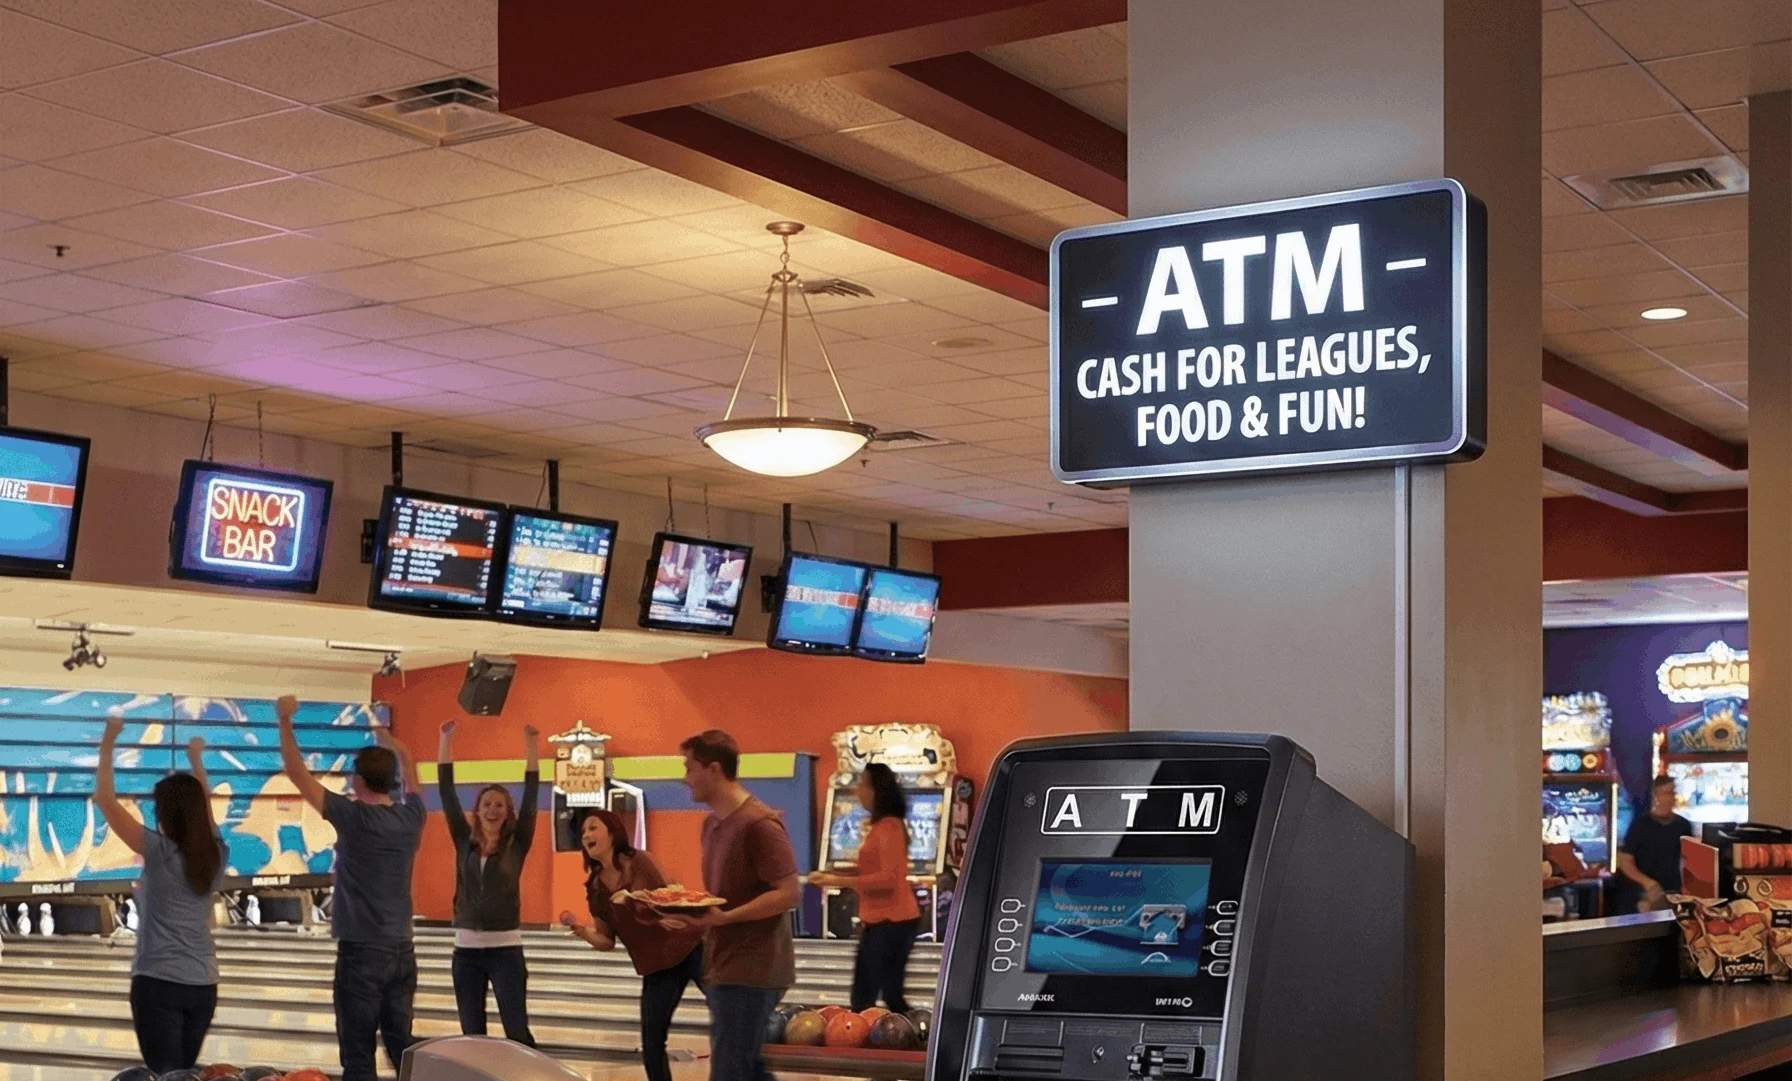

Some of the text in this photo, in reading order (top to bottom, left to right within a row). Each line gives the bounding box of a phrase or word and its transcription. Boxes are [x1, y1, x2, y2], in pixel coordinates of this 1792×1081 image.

[1135, 223, 1365, 336] ATM
[1076, 325, 1432, 399] CASH FOR LEAGUES,
[1137, 385, 1366, 447] FOOD & FUN!
[211, 486, 299, 528] SNACK
[223, 525, 276, 562] BAR
